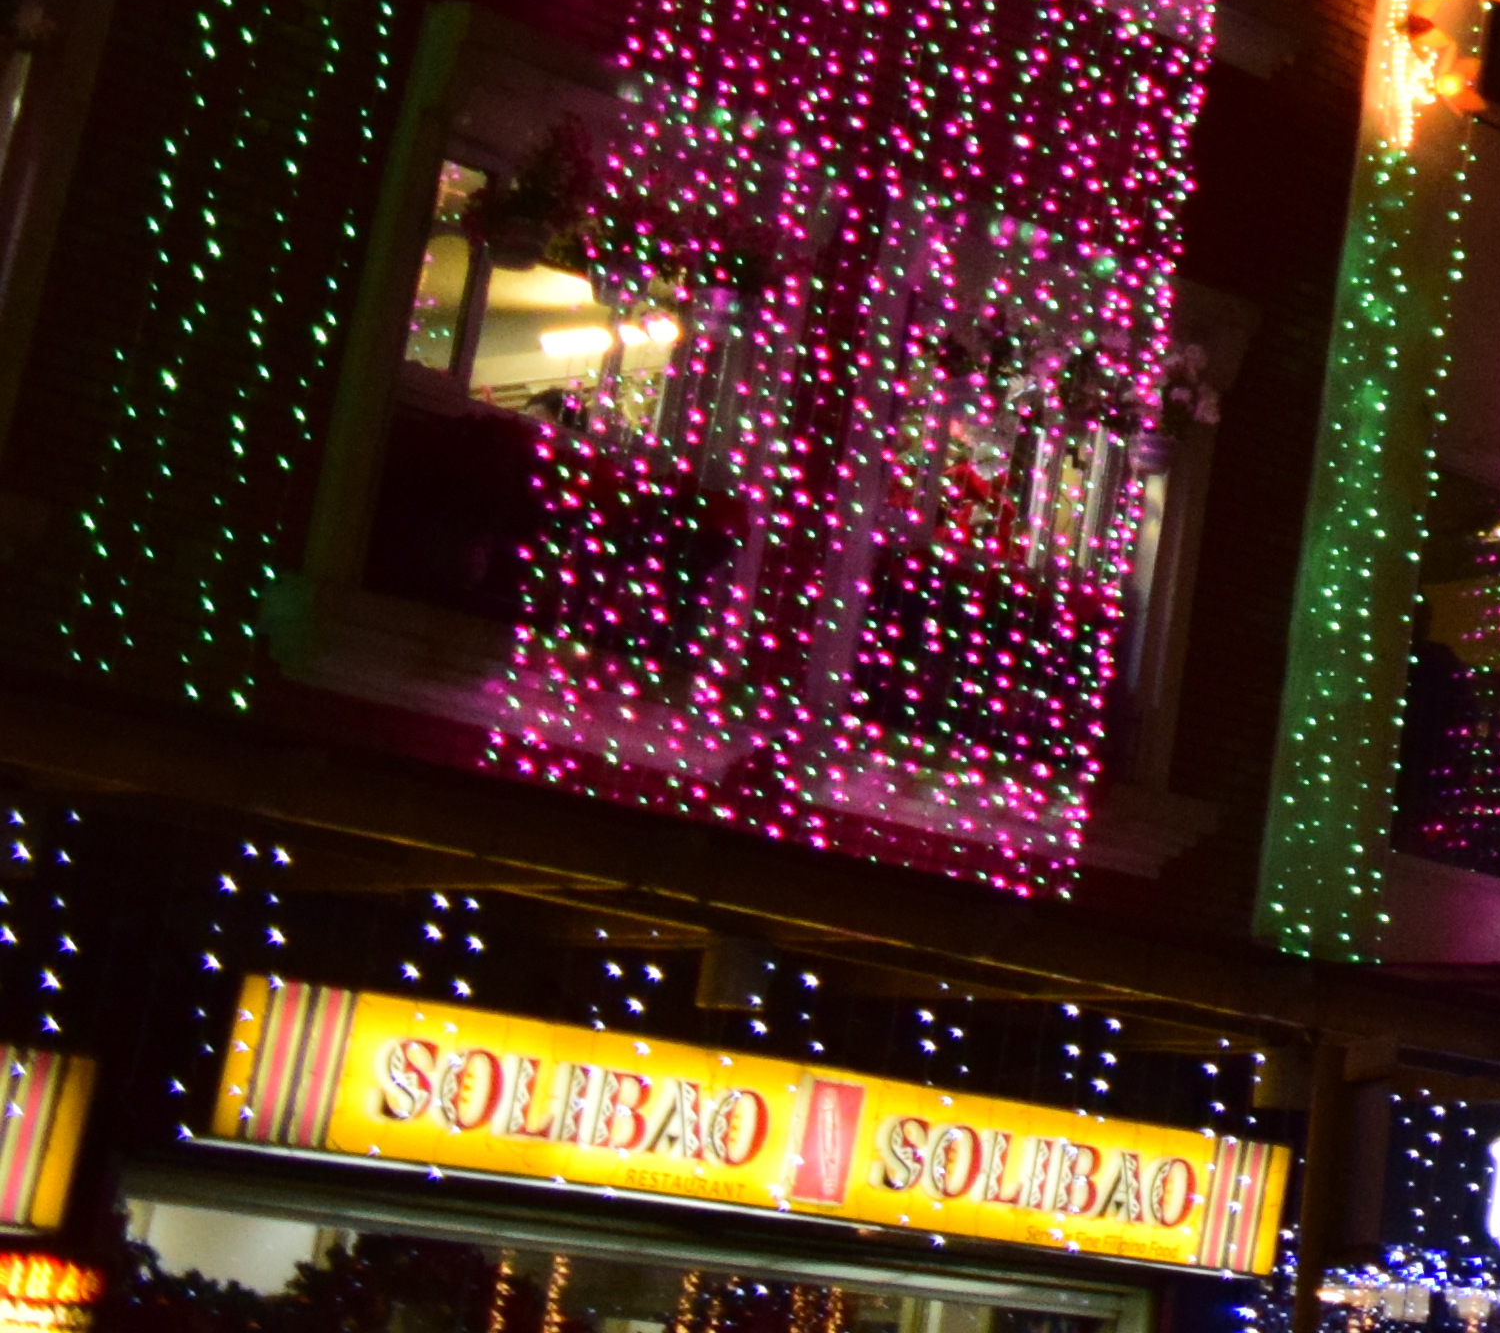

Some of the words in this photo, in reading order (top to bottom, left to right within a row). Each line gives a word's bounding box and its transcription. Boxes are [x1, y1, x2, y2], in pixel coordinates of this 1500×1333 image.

[374, 1037, 769, 1168] SOLIBAO
[625, 1167, 746, 1199] RESTAURANT
[875, 1116, 1198, 1228] SOLIBAO
